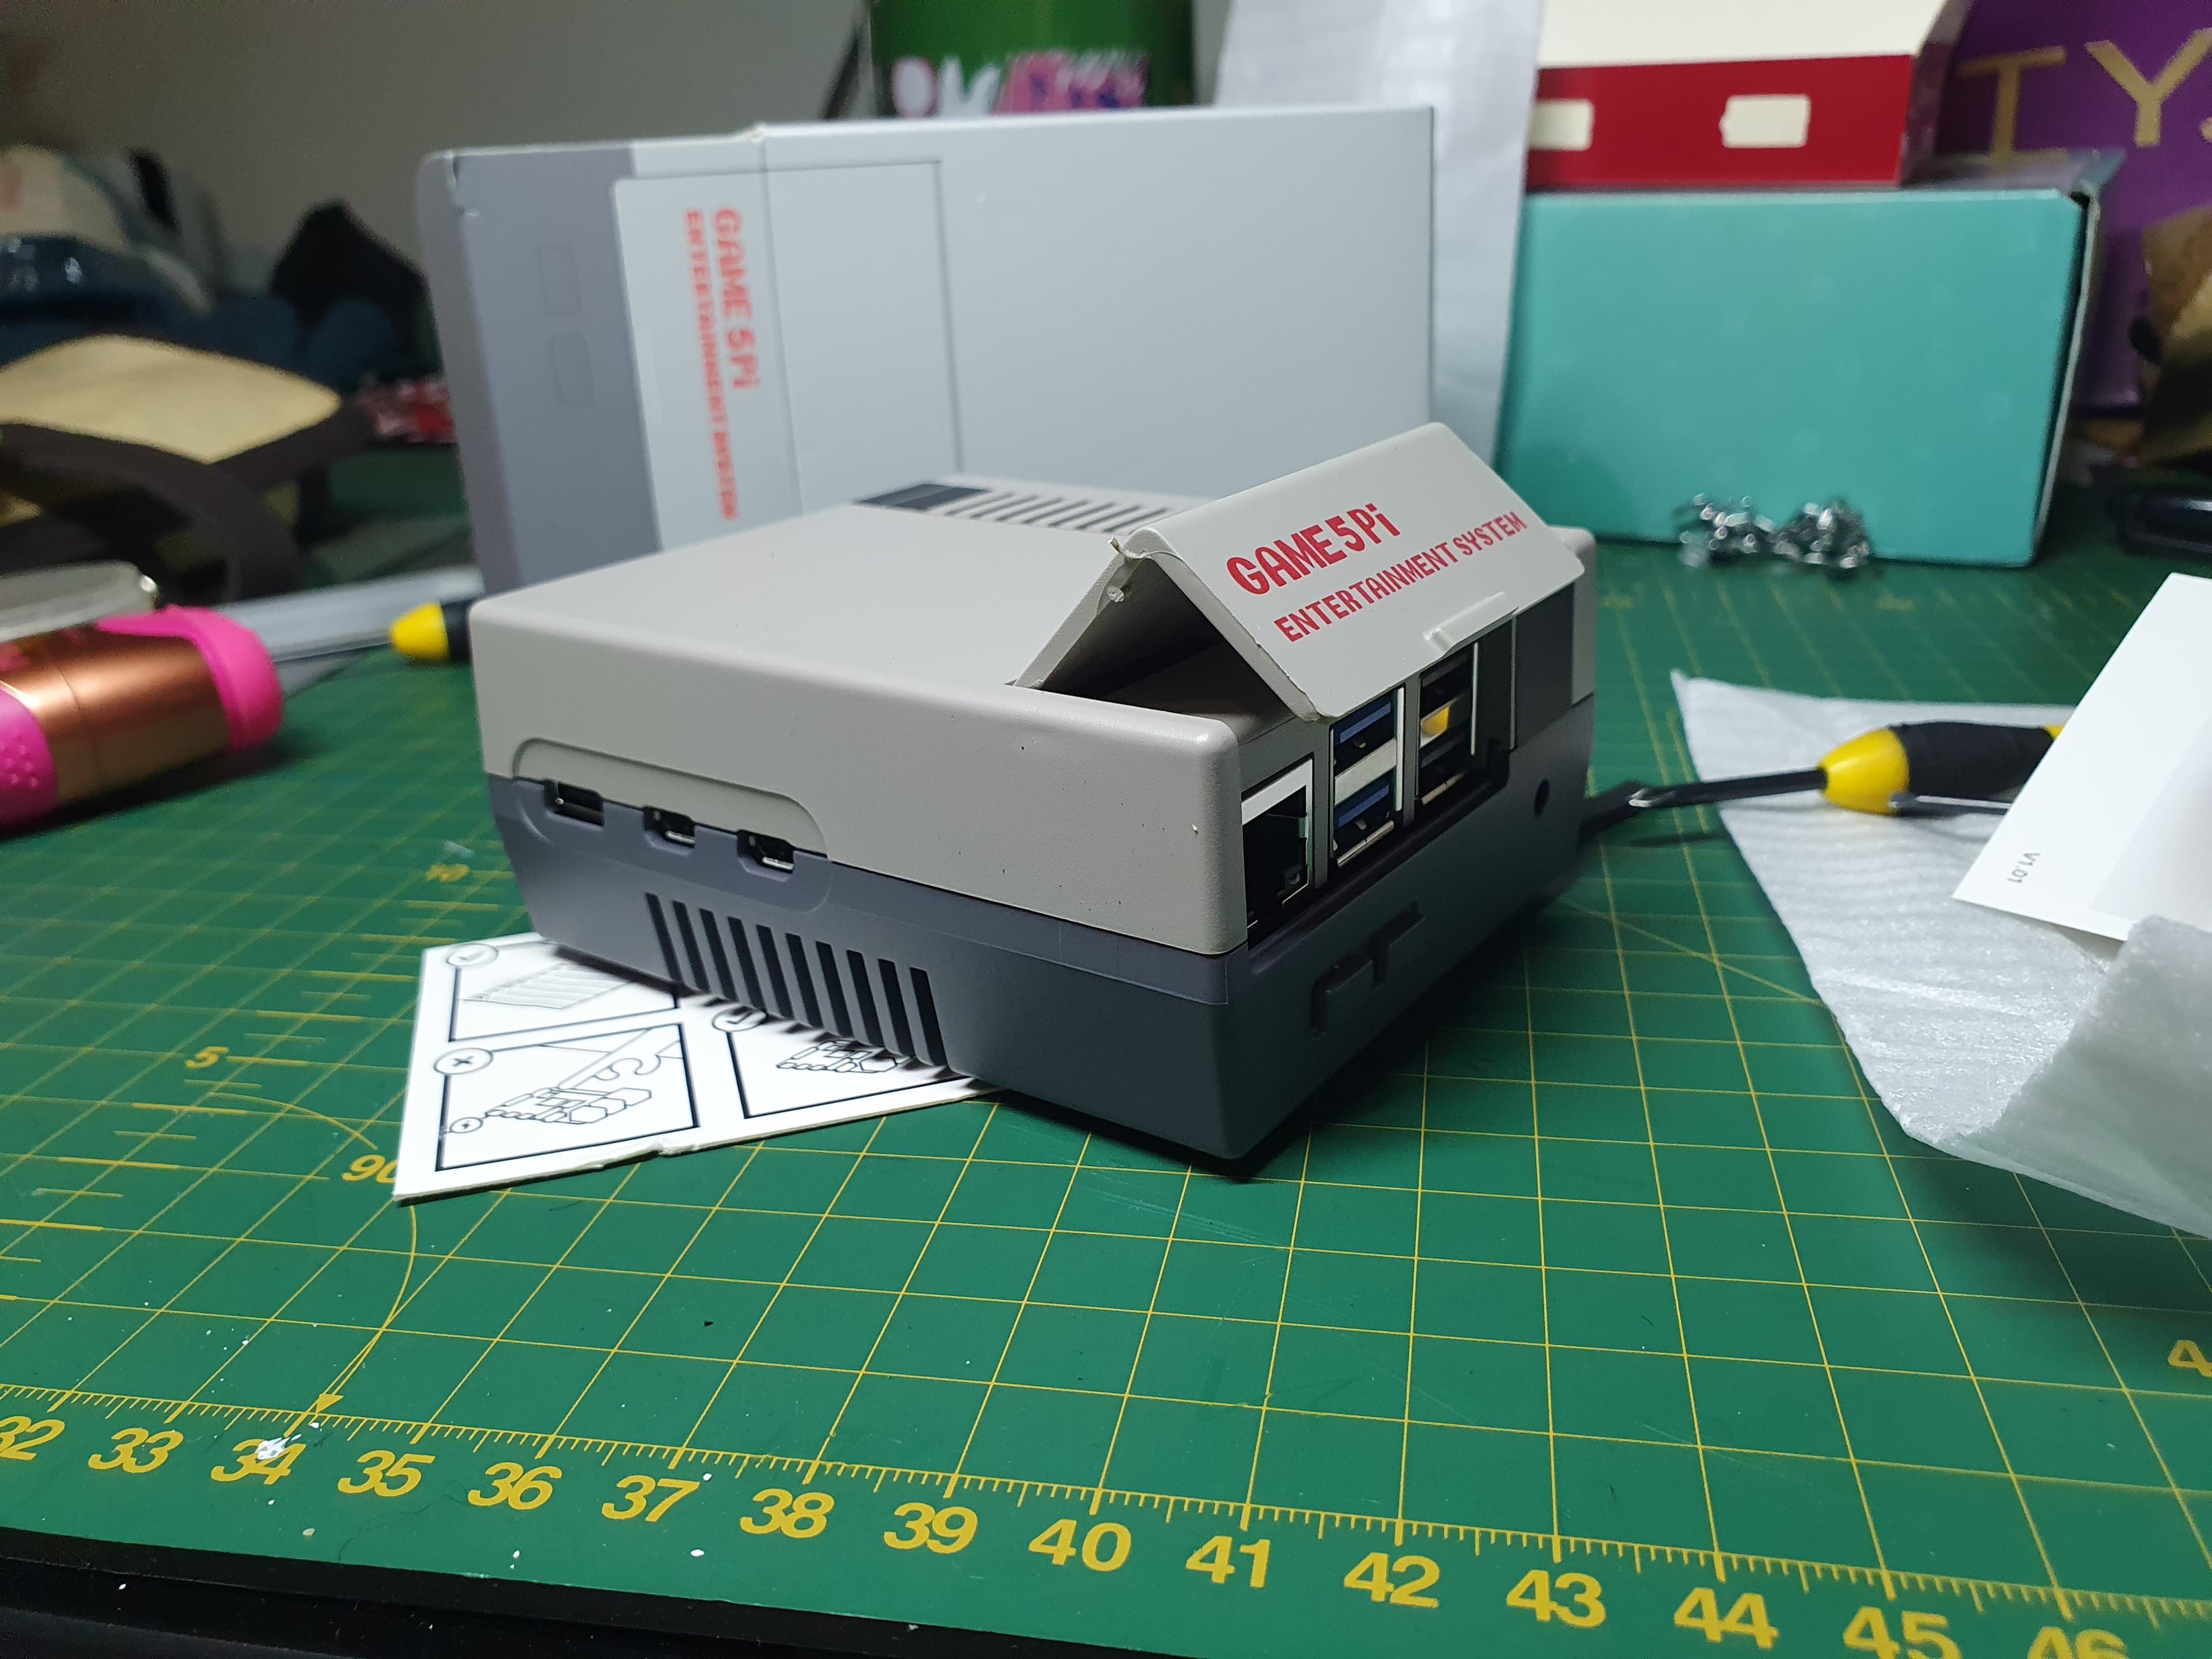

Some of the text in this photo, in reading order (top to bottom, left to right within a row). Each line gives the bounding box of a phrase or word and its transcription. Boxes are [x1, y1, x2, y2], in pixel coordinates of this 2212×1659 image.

[1274, 510, 1528, 642] ENTERTAINMENT SYSTEM
[2007, 852, 2041, 884] V1.01
[185, 1046, 228, 1069] 5
[0, 1415, 65, 1461] 32
[88, 1427, 183, 1474] 33
[211, 1439, 306, 1485] 34
[338, 1450, 435, 1497] 35
[468, 1462, 562, 1510] 36
[602, 1475, 700, 1523] 37
[740, 1488, 835, 1539] 38
[883, 1502, 978, 1554] 39
[1028, 1518, 1131, 1572] 40
[1185, 1535, 1271, 1588] 41
[1343, 1552, 1441, 1608] 42
[1506, 1569, 1606, 1628] 43
[1673, 1586, 1779, 1649] 44
[1843, 1606, 1962, 1659] 45
